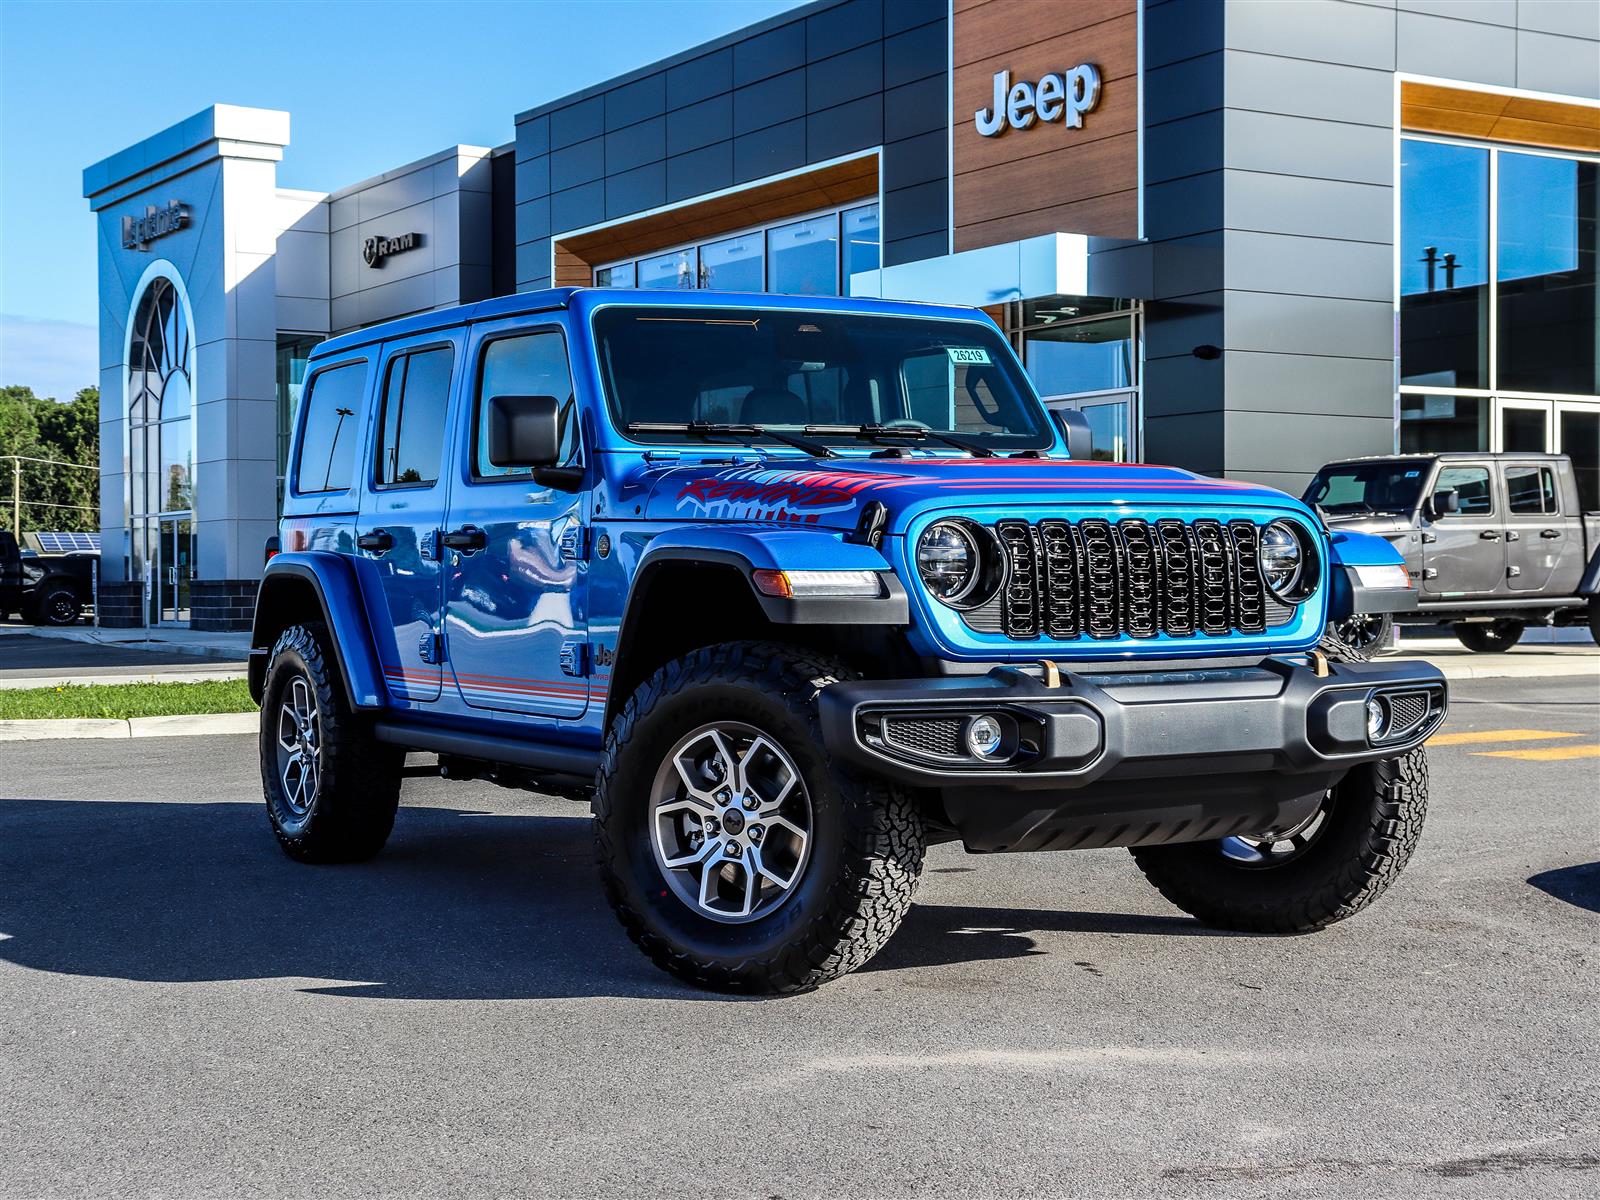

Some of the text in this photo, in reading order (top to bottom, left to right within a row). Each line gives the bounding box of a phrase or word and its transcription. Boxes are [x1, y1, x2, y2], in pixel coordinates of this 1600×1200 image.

[975, 63, 1101, 137] Jeep
[379, 232, 415, 256] RAM
[953, 350, 983, 361] 26219
